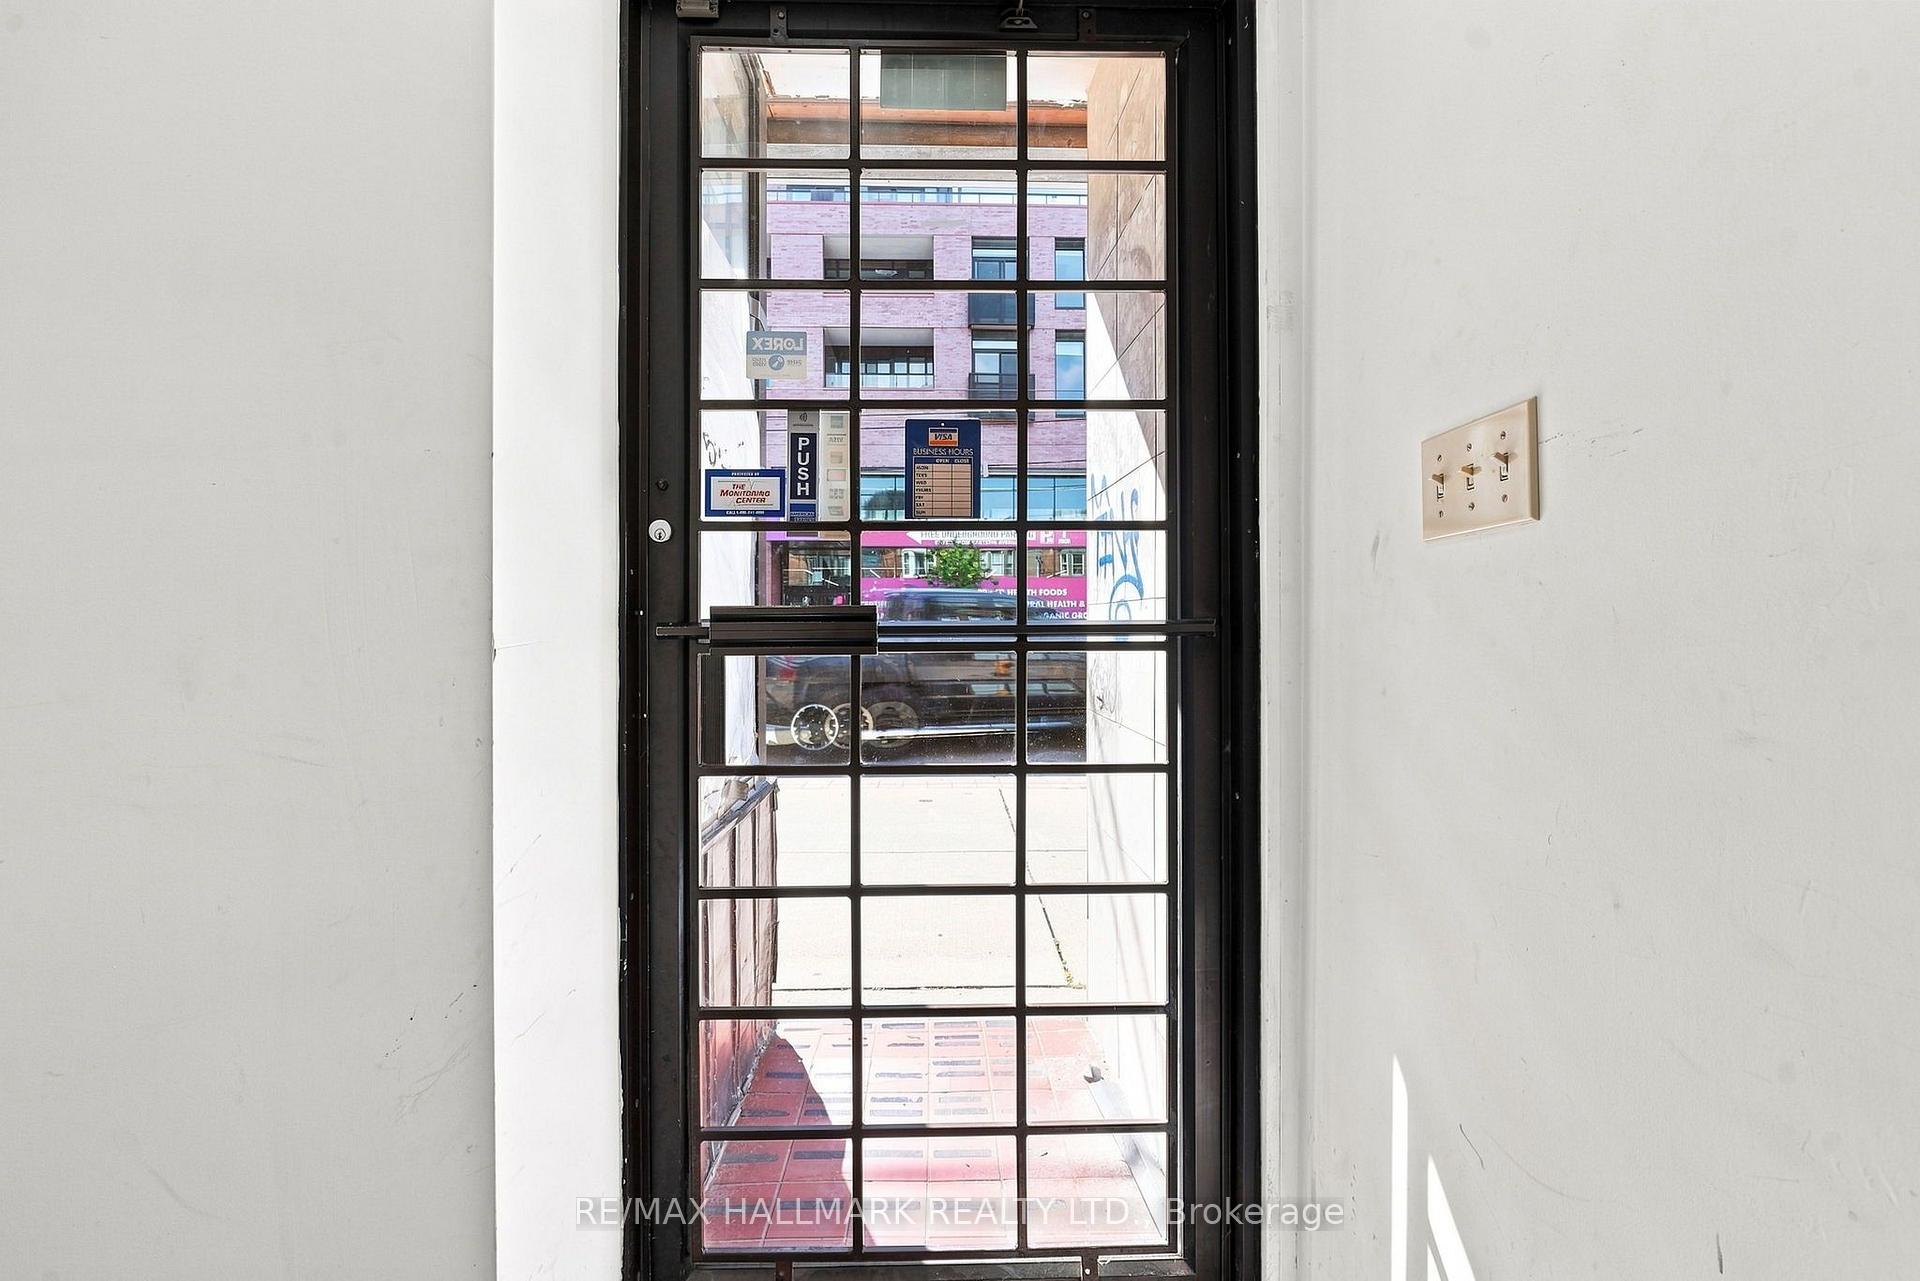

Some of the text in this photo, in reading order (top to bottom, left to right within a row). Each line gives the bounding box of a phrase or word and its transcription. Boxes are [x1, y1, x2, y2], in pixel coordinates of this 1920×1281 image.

[934, 433, 953, 441] VISA
[913, 448, 974, 456] BUSINESS HOURS
[796, 437, 810, 496] PUSH
[719, 489, 771, 497] MONITORING
[1039, 588, 1068, 596] FOODS
[1046, 600, 1077, 608] HEALTH
[1078, 600, 1086, 608] &
